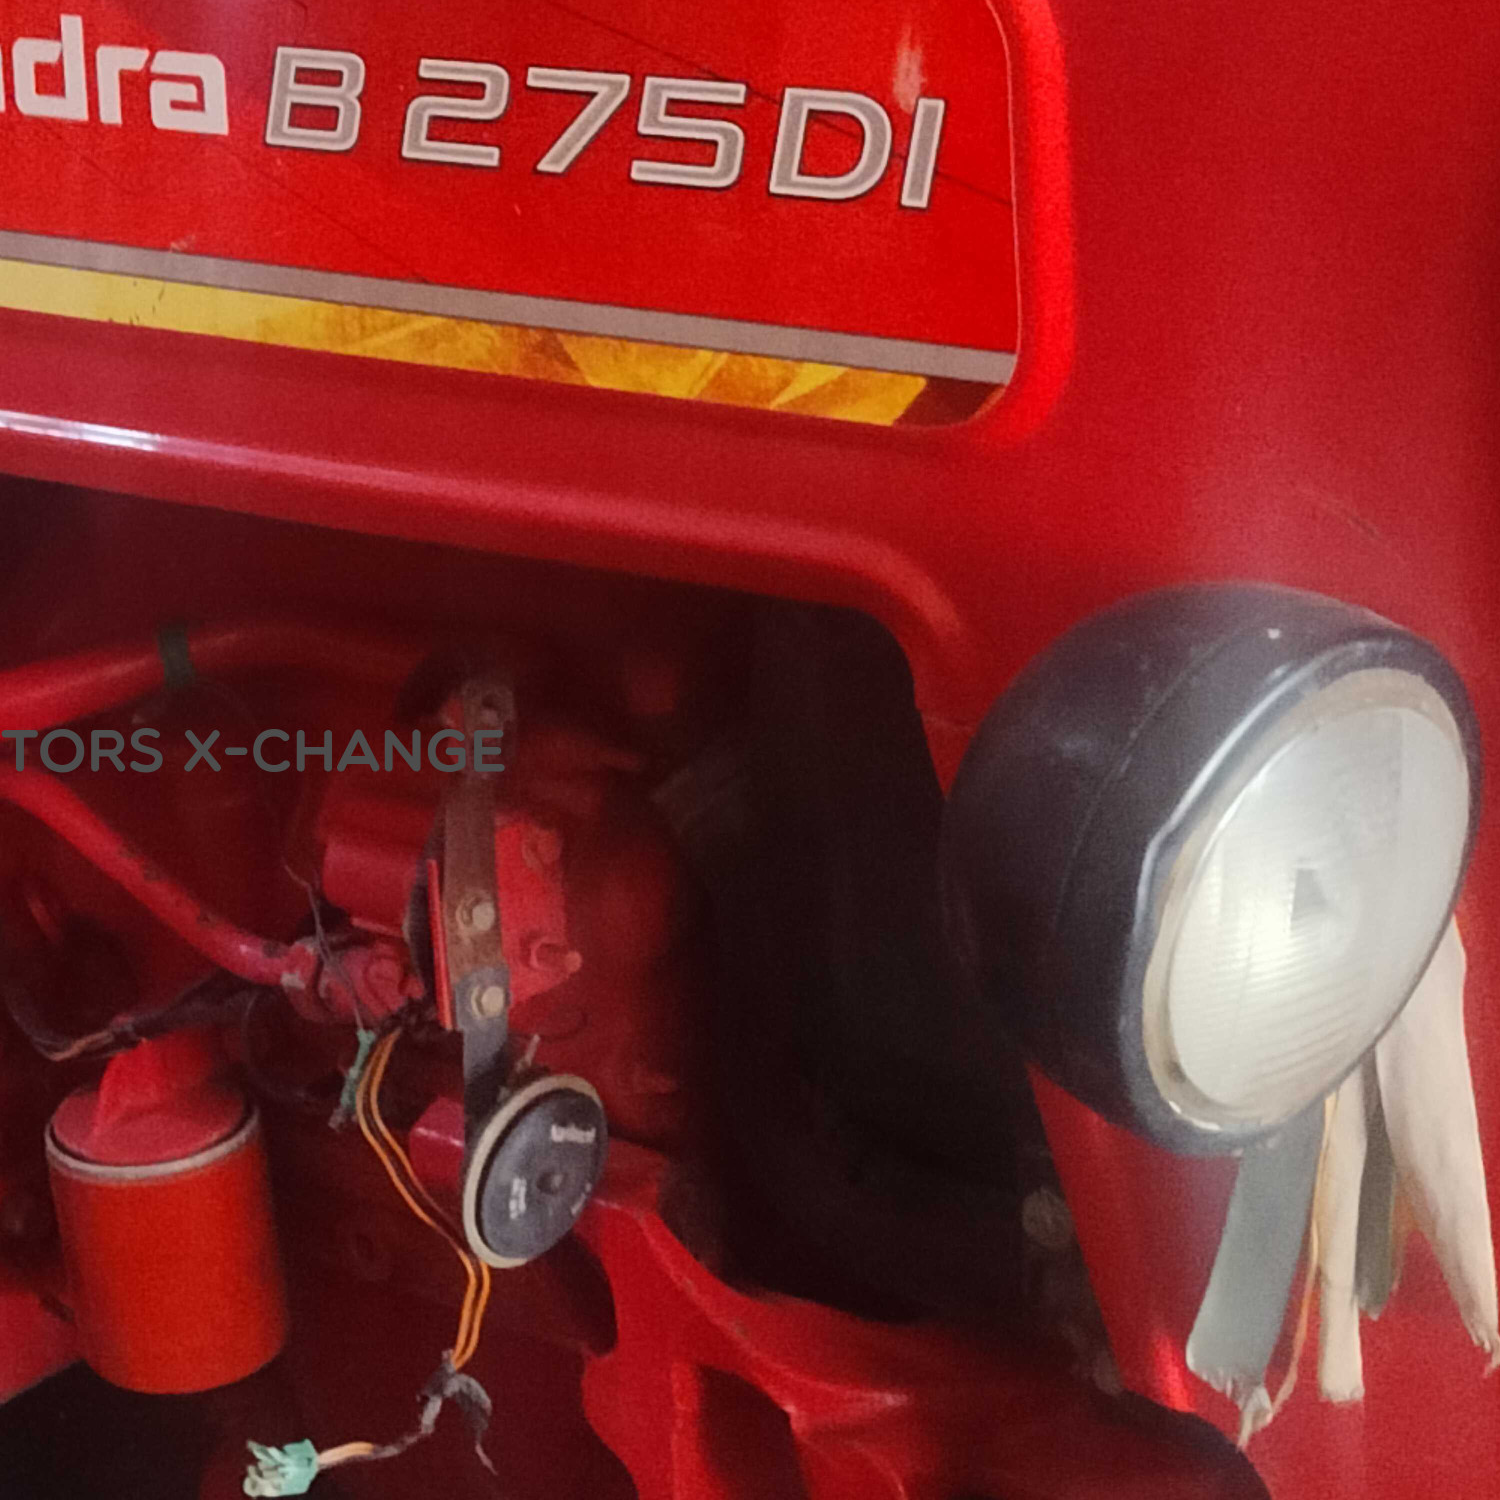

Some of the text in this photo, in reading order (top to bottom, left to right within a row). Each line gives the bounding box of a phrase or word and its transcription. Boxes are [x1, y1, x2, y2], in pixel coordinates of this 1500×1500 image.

[263, 45, 366, 153] B
[400, 57, 748, 191] 275
[767, 86, 946, 211] DI
